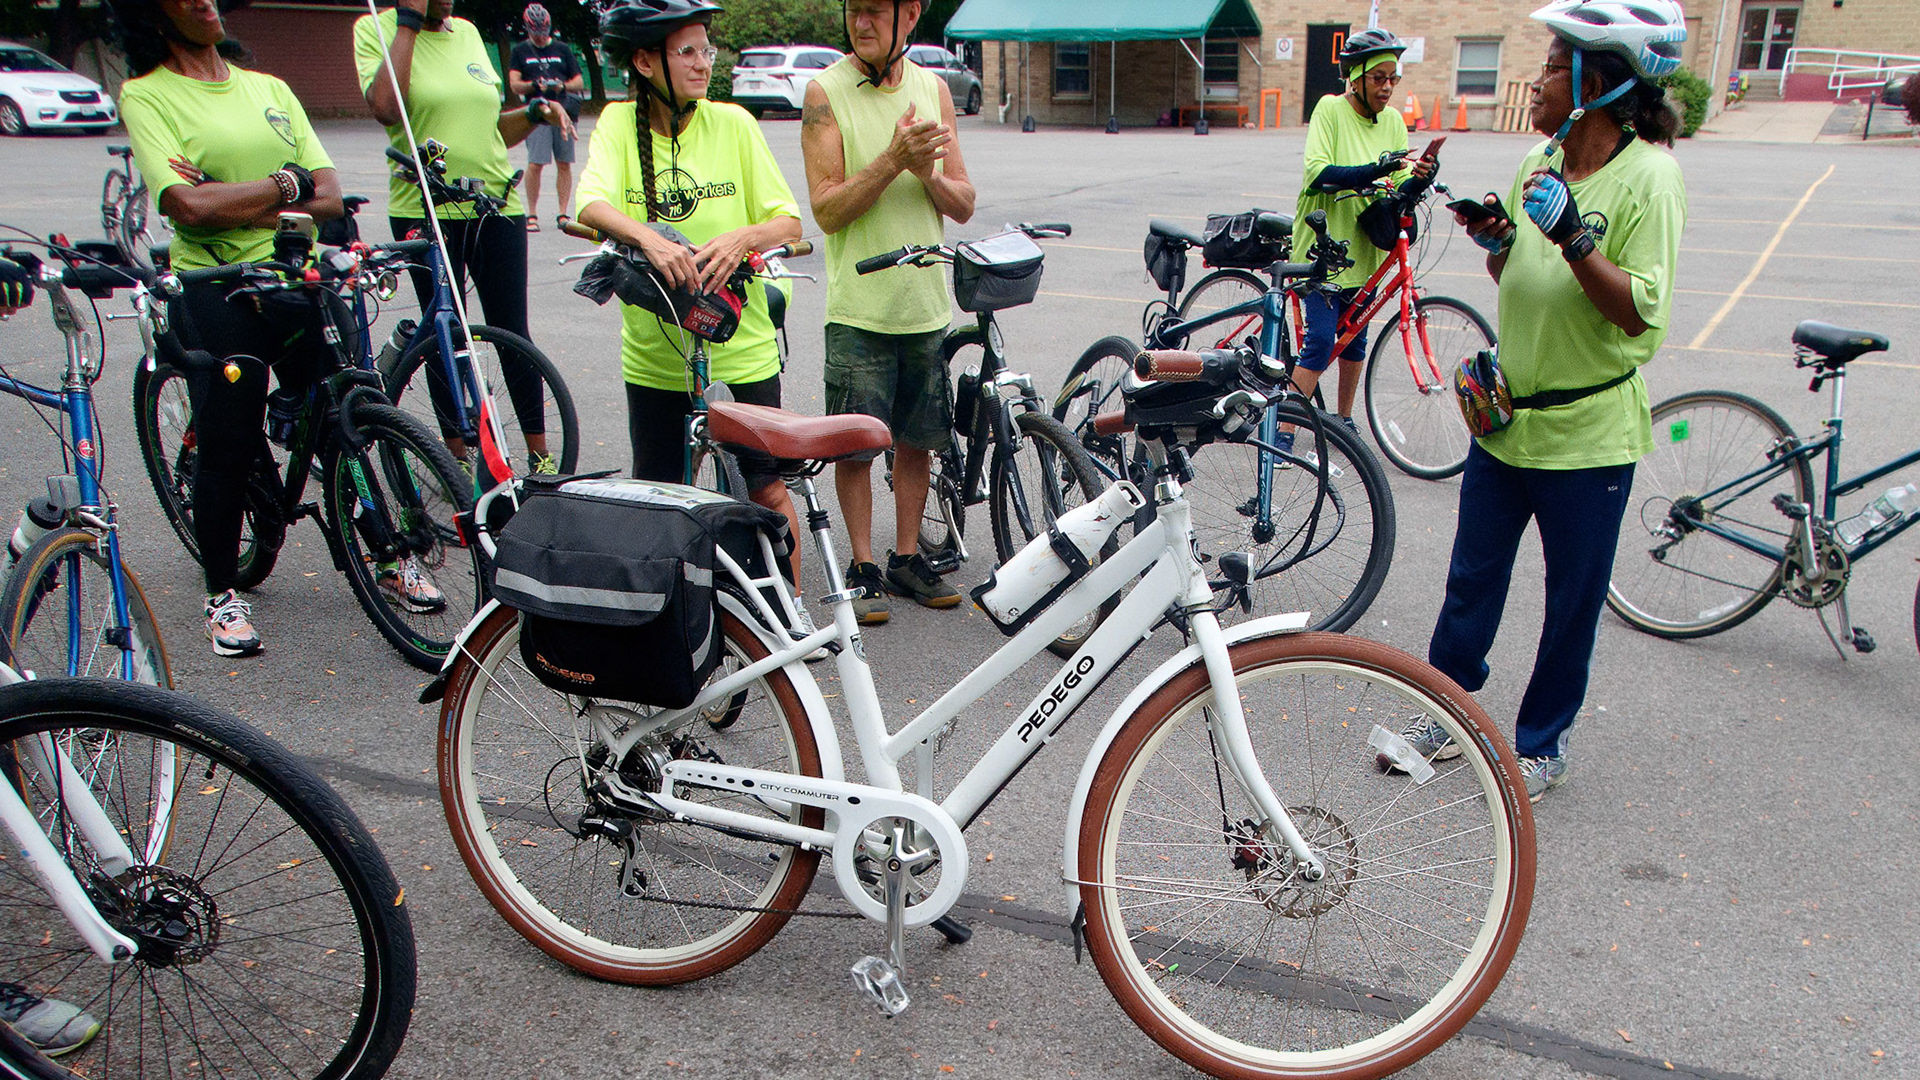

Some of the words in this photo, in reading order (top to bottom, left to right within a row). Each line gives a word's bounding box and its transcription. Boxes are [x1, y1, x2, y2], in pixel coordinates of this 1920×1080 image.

[626, 188, 665, 205] whes
[683, 182, 736, 203] workers
[668, 203, 683, 218] 716
[1357, 289, 1387, 325] RALEIGH
[1017, 655, 1095, 744] PEDEGO
[760, 783, 781, 791] CITY
[783, 786, 839, 801] COMMUTER
